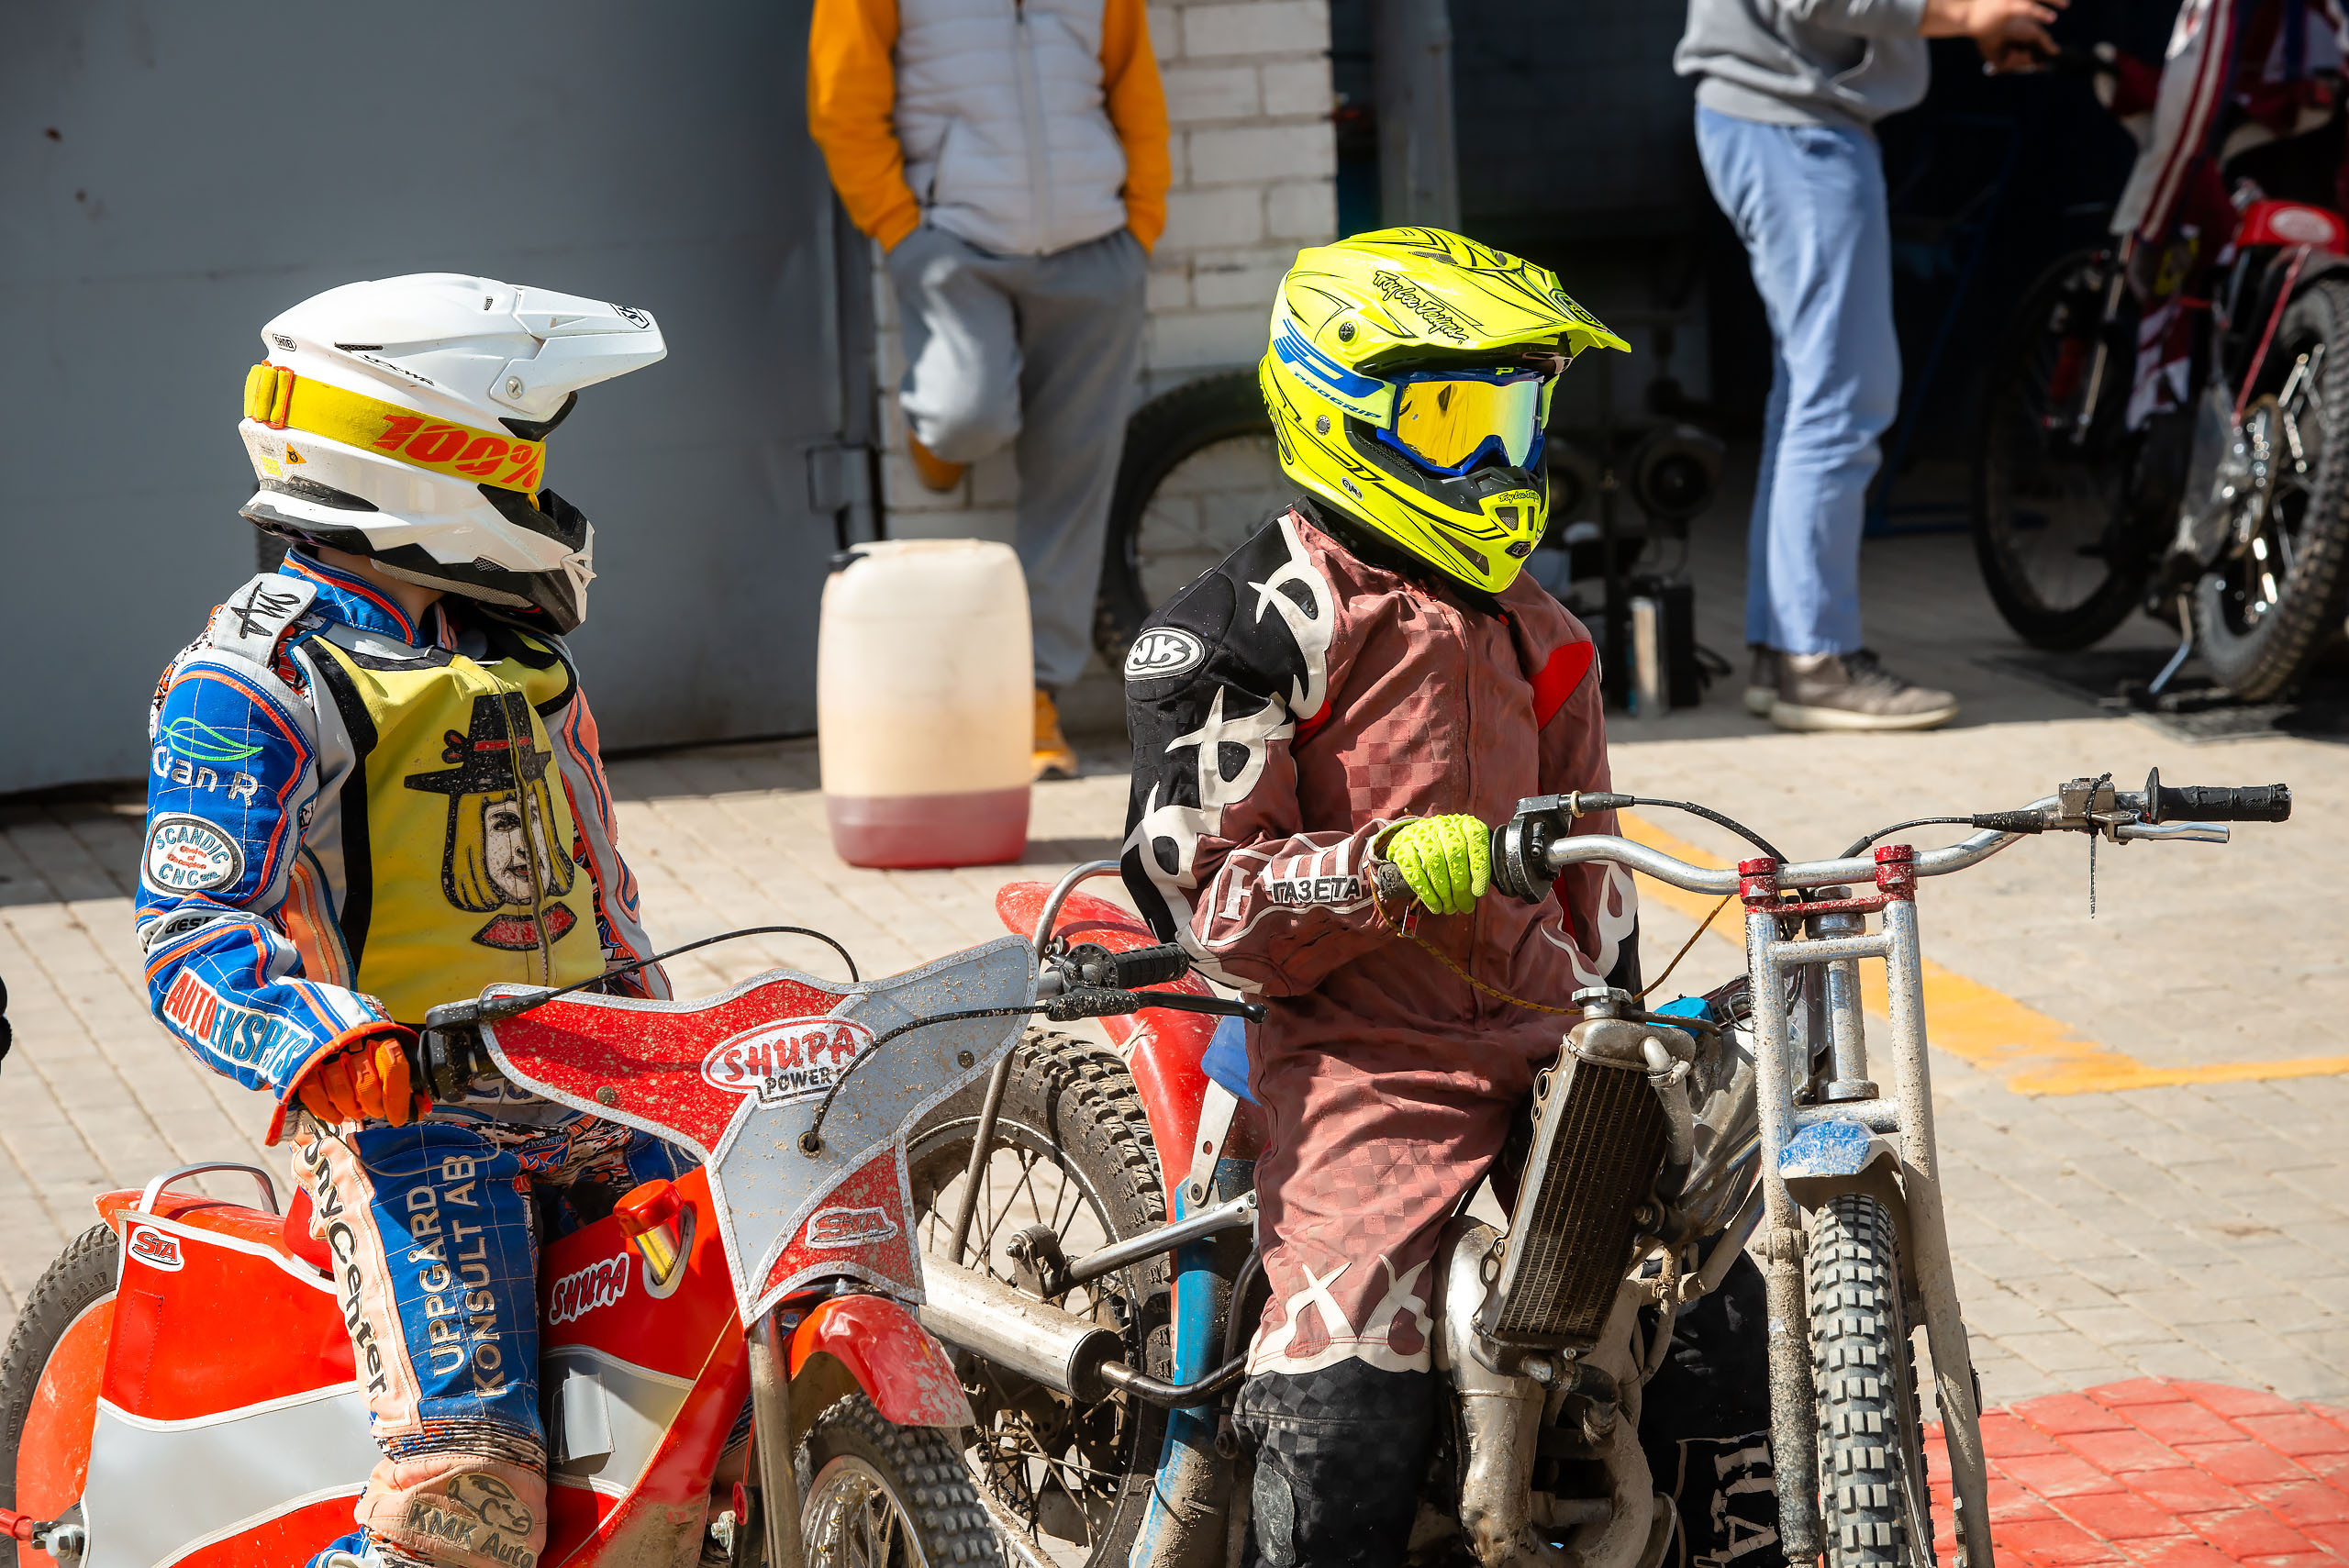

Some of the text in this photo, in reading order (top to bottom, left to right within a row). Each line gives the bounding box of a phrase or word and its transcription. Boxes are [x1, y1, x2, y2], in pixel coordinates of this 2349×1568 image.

[1373, 270, 1470, 341] Troy Lee Designs
[275, 336, 295, 350] SHOEI
[1294, 371, 1382, 418] PROGRIP
[373, 414, 542, 488] 100%
[155, 826, 229, 864] SCANDIC
[159, 863, 199, 886] CNC
[1273, 876, 1361, 903] ГАЗЕТА
[724, 1026, 856, 1083] SHUPA
[764, 1065, 841, 1095] POWER
[133, 1231, 178, 1262] STA
[406, 1185, 465, 1377] UPPGÅRD
[442, 1155, 507, 1398] KONSULT AB
[551, 1257, 627, 1320] SHUPA
[408, 1502, 535, 1568] KMK Auto
